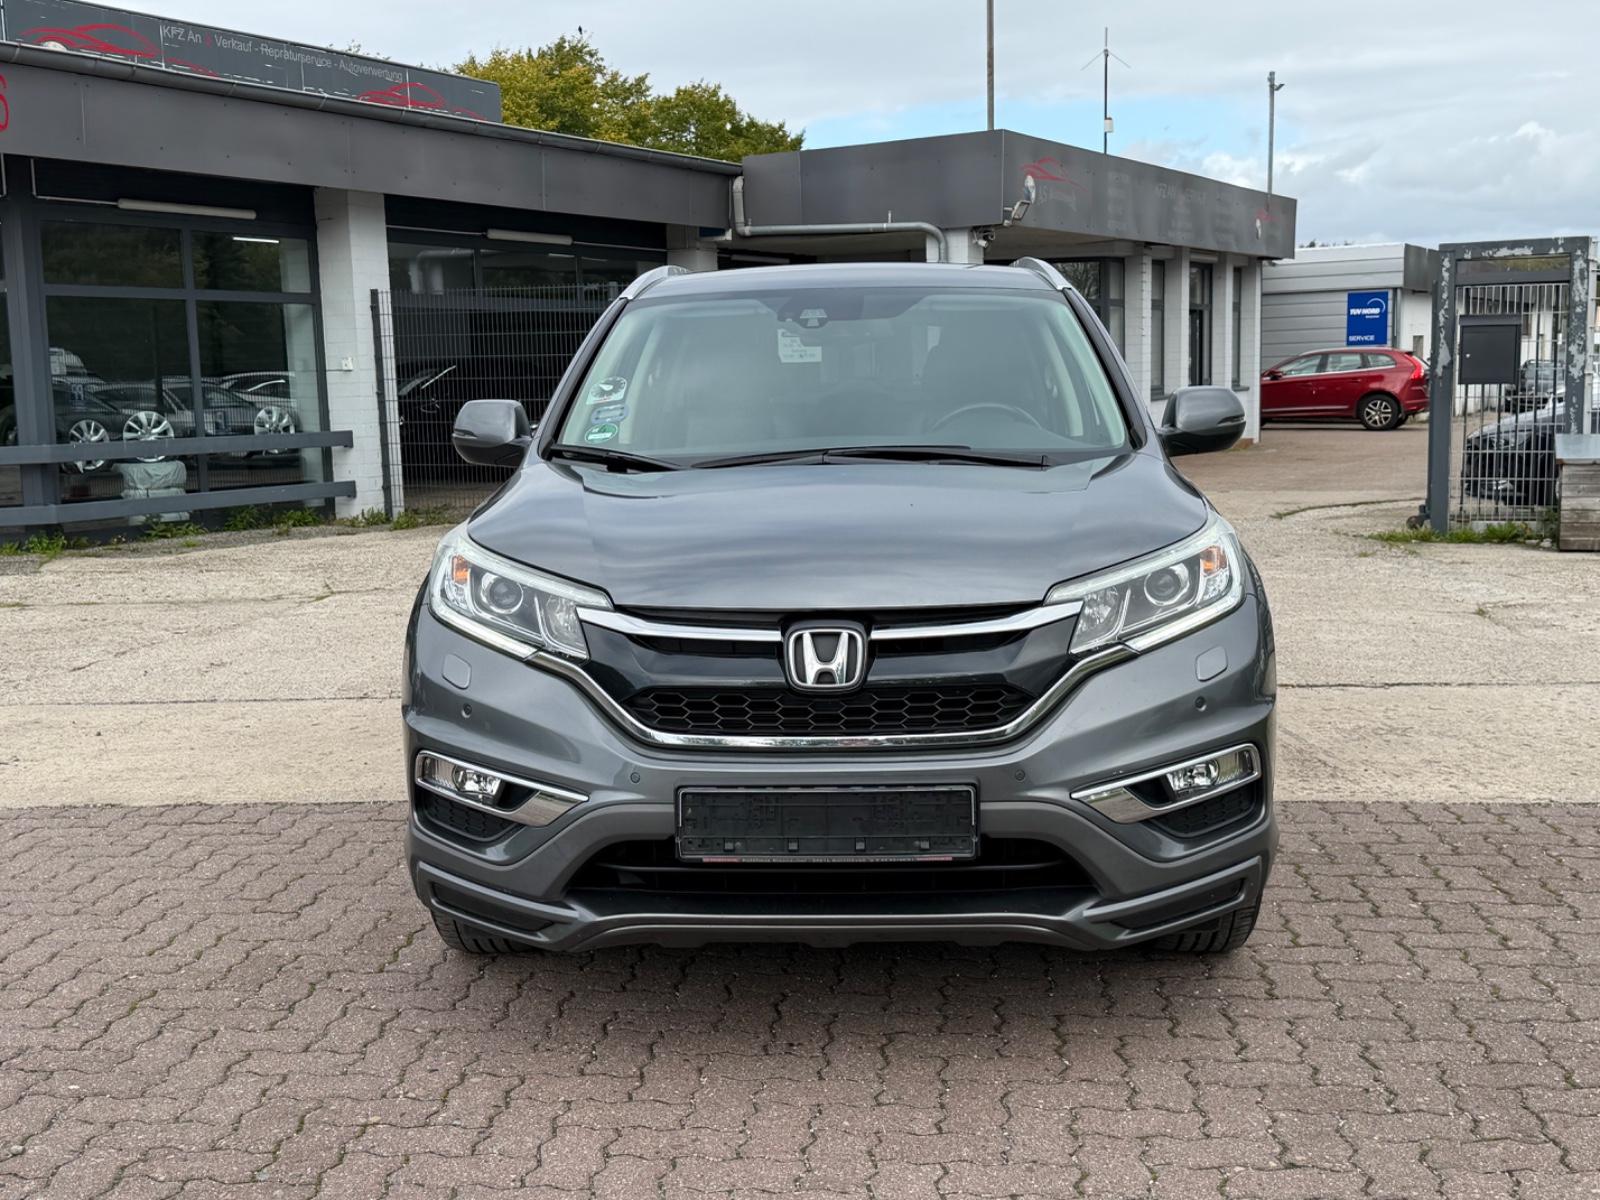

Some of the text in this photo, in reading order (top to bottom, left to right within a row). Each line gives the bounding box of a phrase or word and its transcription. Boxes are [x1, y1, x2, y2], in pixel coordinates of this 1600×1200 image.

[163, 24, 185, 41] KFZ
[187, 30, 202, 44] An
[214, 34, 253, 53] Verkauf
